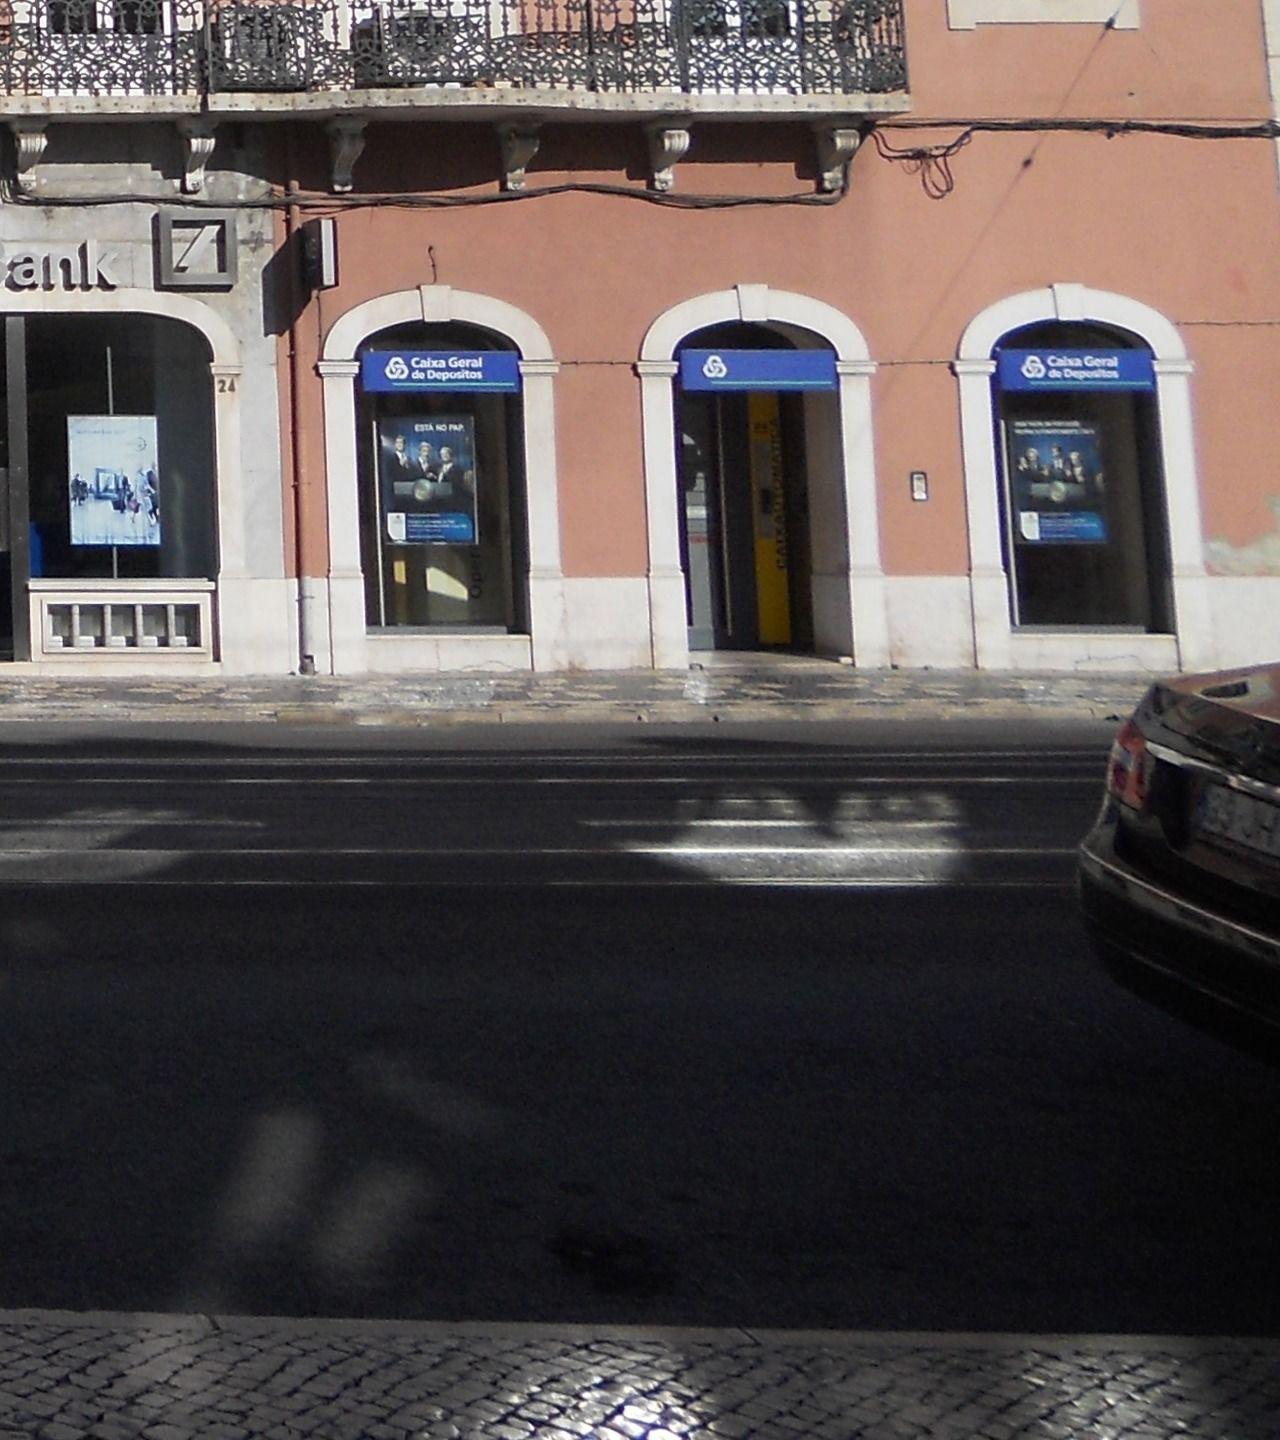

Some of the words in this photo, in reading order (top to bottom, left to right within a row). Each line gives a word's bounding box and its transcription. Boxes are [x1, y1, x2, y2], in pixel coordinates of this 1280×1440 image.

[411, 356, 447, 368] Caixa
[448, 356, 483, 368] Geral
[1046, 355, 1082, 367] Caixa
[1084, 355, 1119, 367] Geral
[411, 370, 426, 380] de
[217, 378, 237, 393] 24
